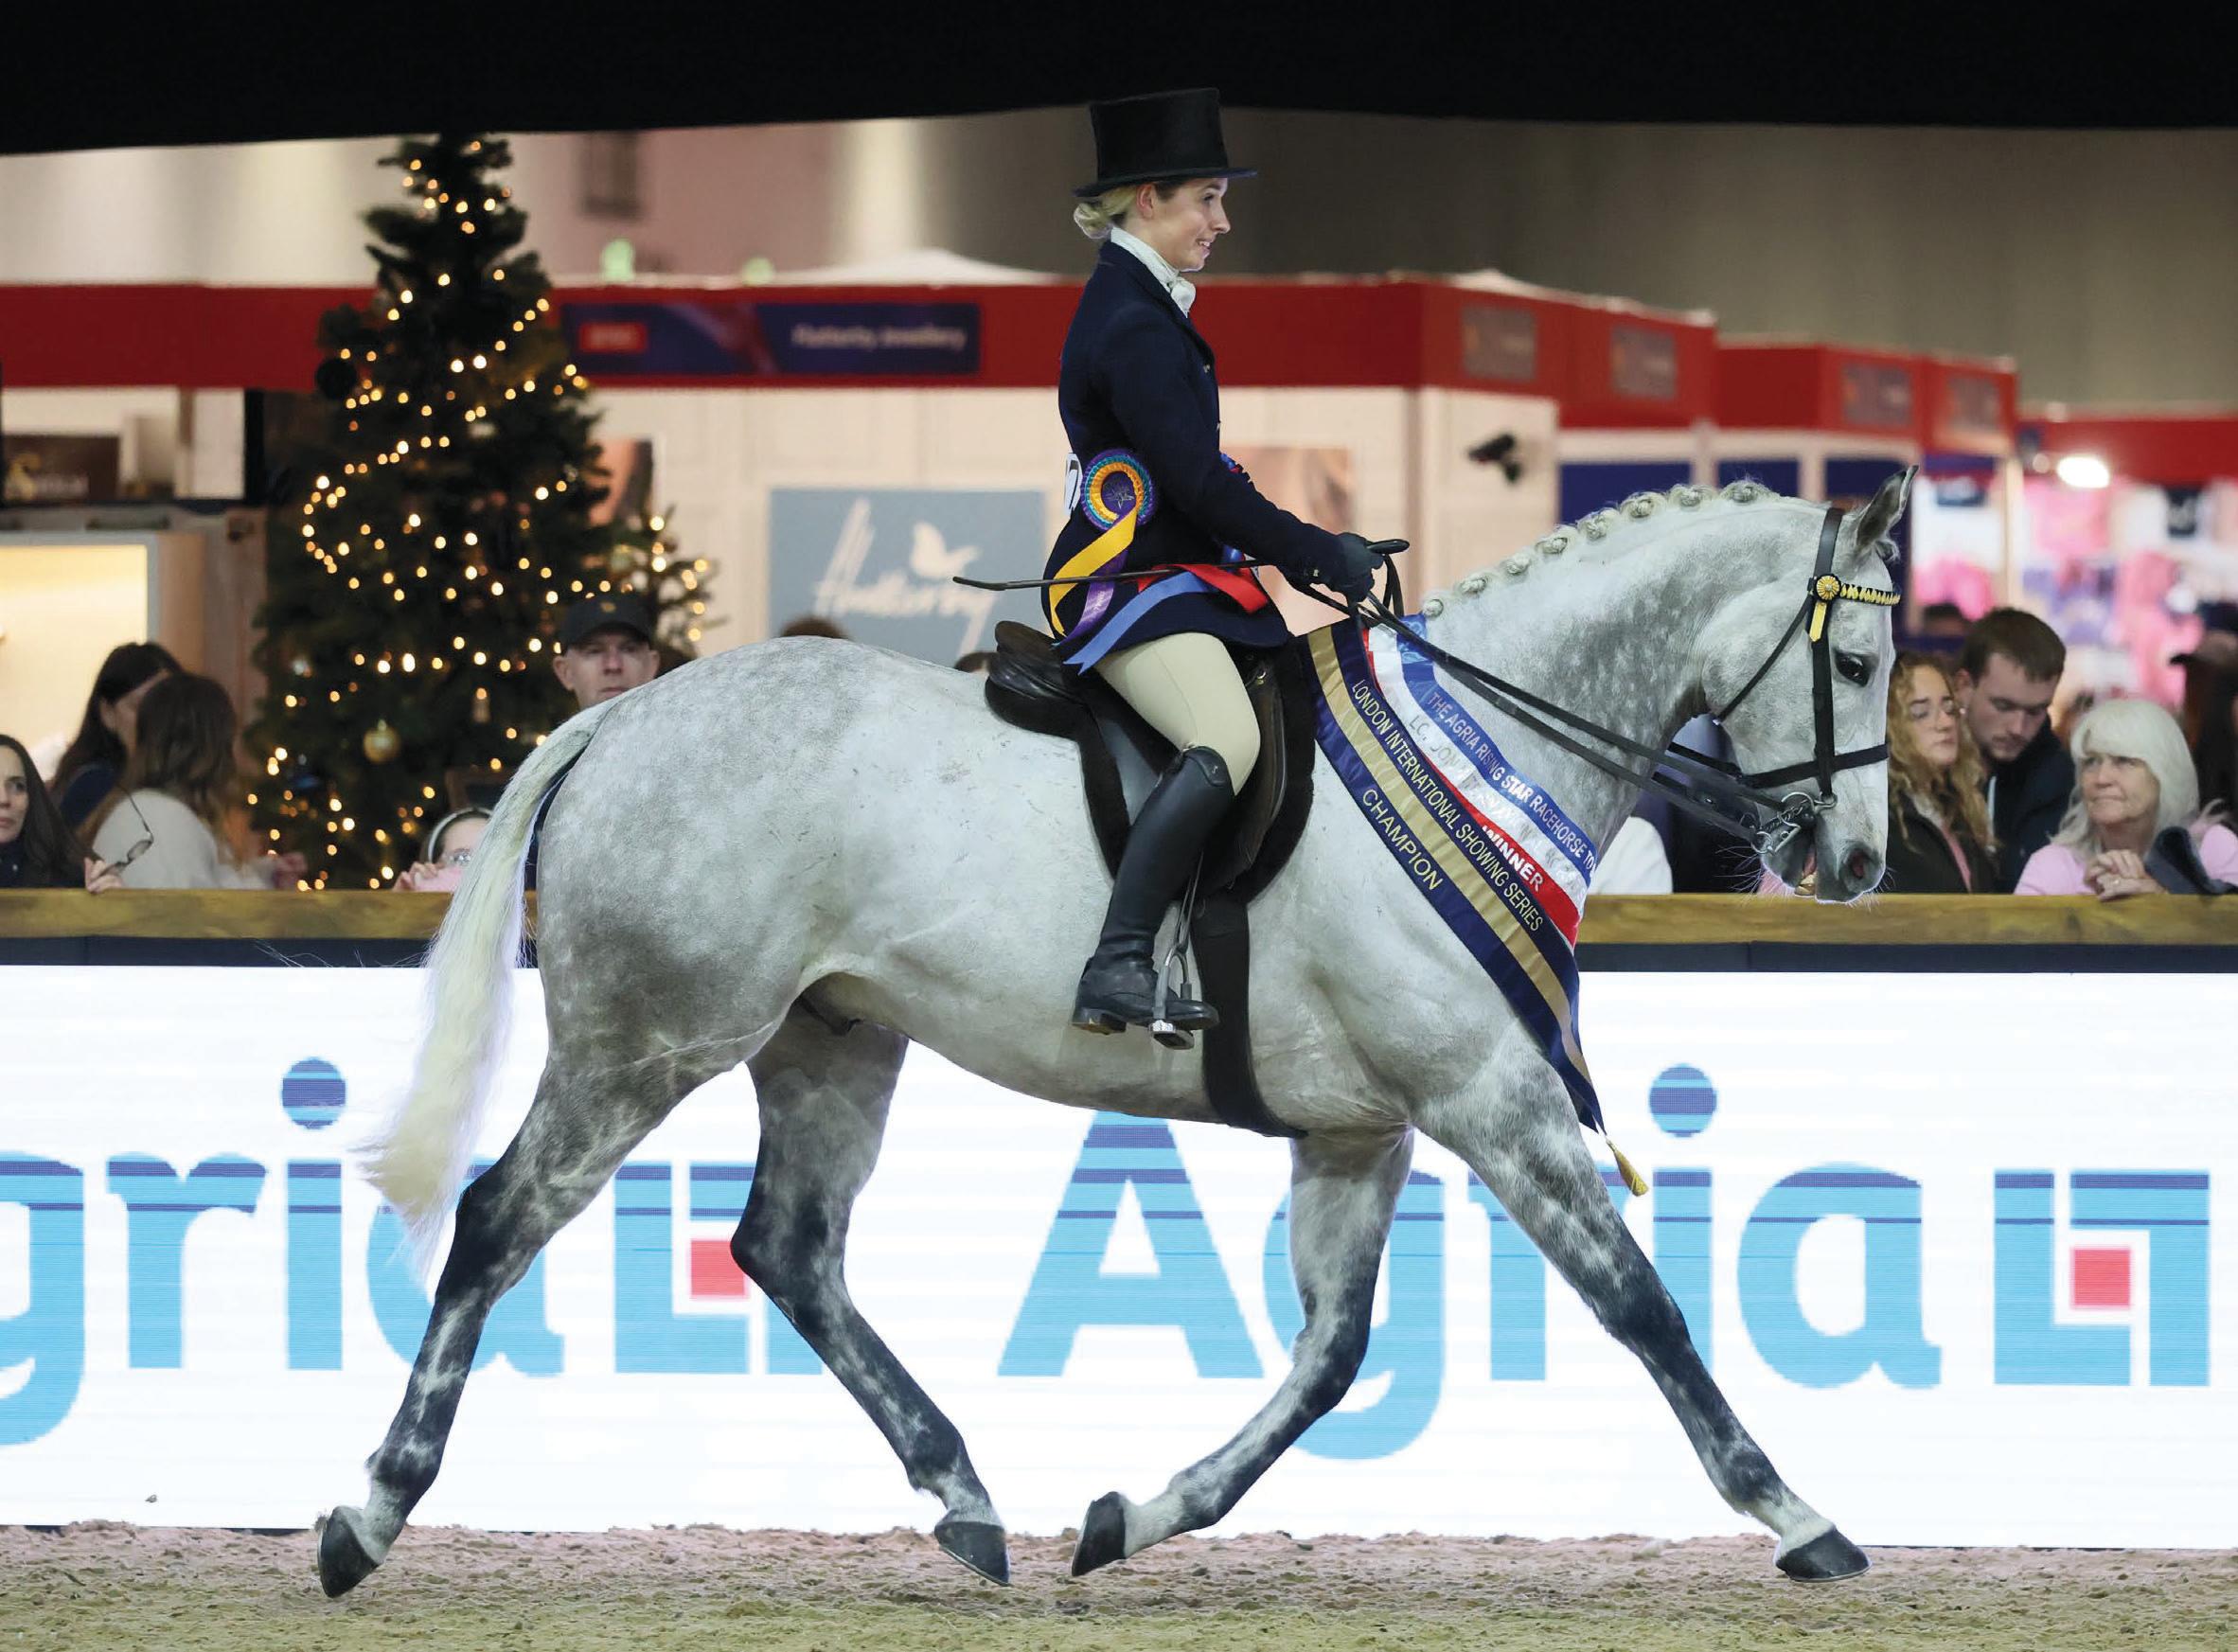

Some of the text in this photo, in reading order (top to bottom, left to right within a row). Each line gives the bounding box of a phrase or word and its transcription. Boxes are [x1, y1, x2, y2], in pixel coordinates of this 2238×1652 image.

[1352, 679, 1394, 736] LONDON
[1384, 729, 1461, 830] INTERNATIONAL
[1455, 823, 1510, 887] SHOWING
[1503, 882, 1543, 932] SERIES
[1362, 789, 1444, 891] CHAMPION
[1427, 691, 1454, 719] THE
[1444, 713, 1481, 751] AGRIA
[1474, 743, 1506, 781] RISING
[1501, 774, 1535, 804] STAR
[1529, 794, 1589, 859] RACEHORSE
[998, 1063, 1942, 1460] Agria
